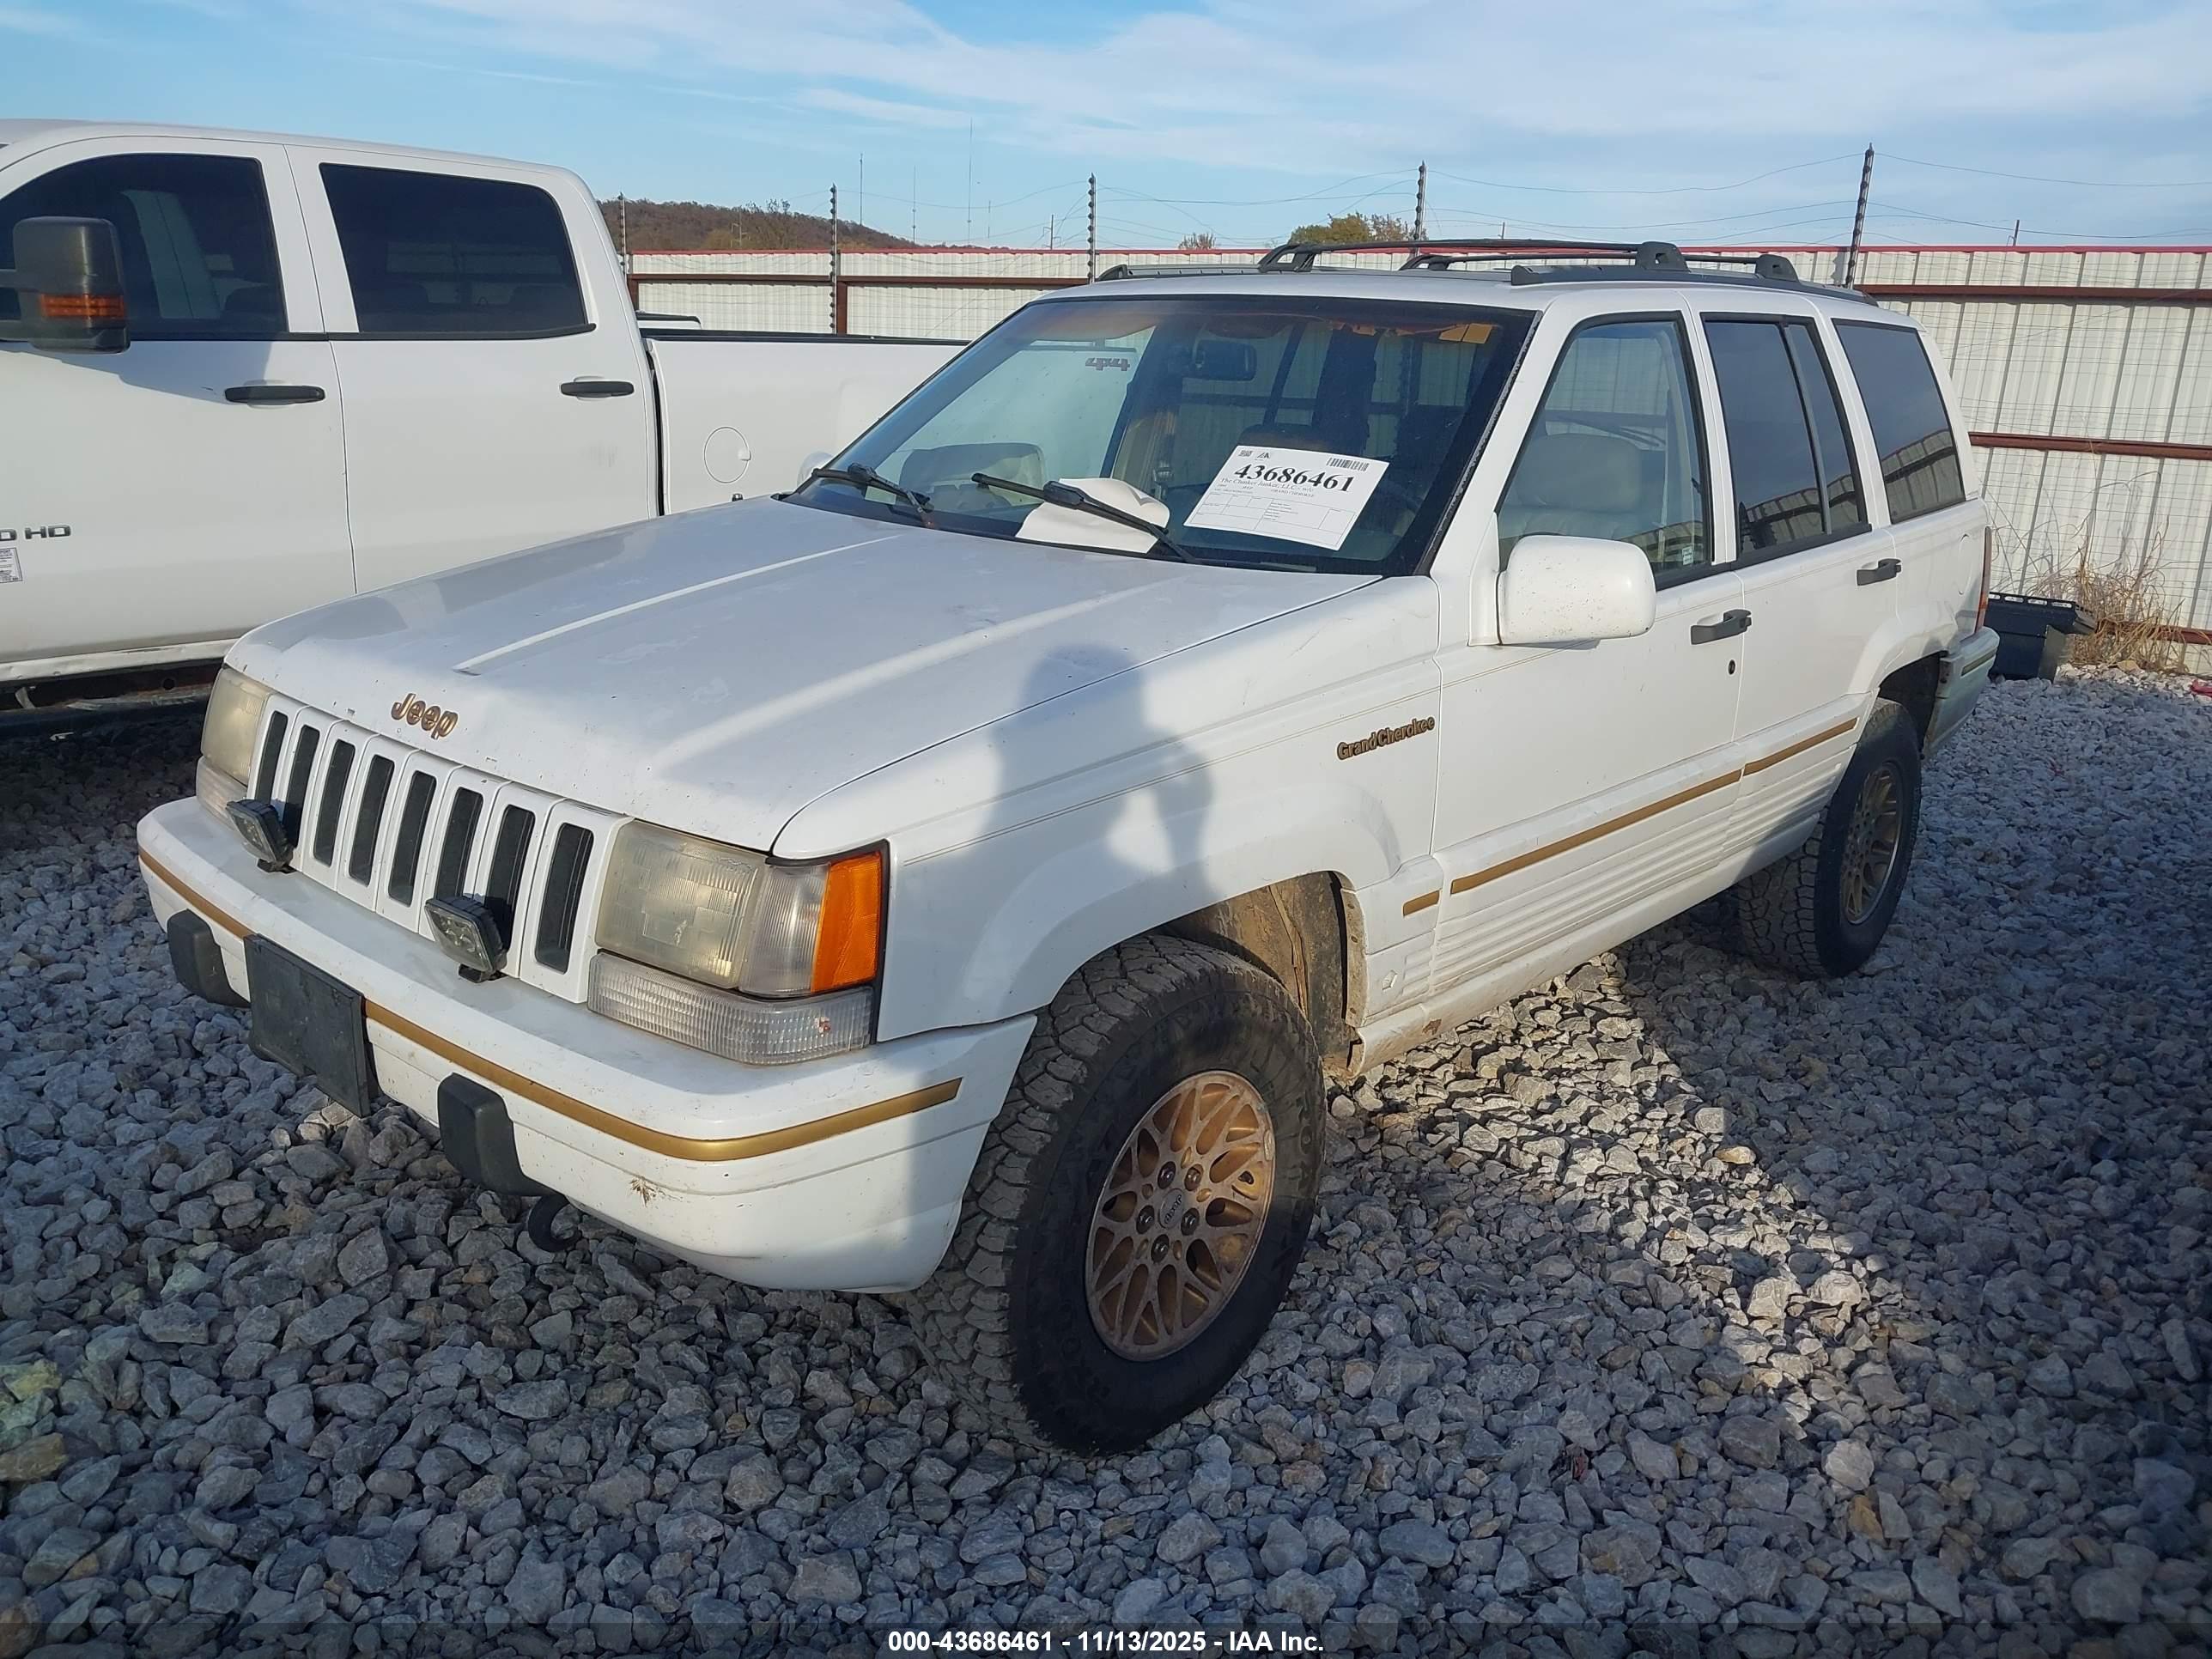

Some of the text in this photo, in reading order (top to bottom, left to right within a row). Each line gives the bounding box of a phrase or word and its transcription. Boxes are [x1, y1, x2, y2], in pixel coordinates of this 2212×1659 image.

[1234, 464, 1355, 493] 43686461
[25, 525, 71, 539] HD
[391, 693, 459, 740] Jeep
[1337, 716, 1436, 760] Grand Cherokee
